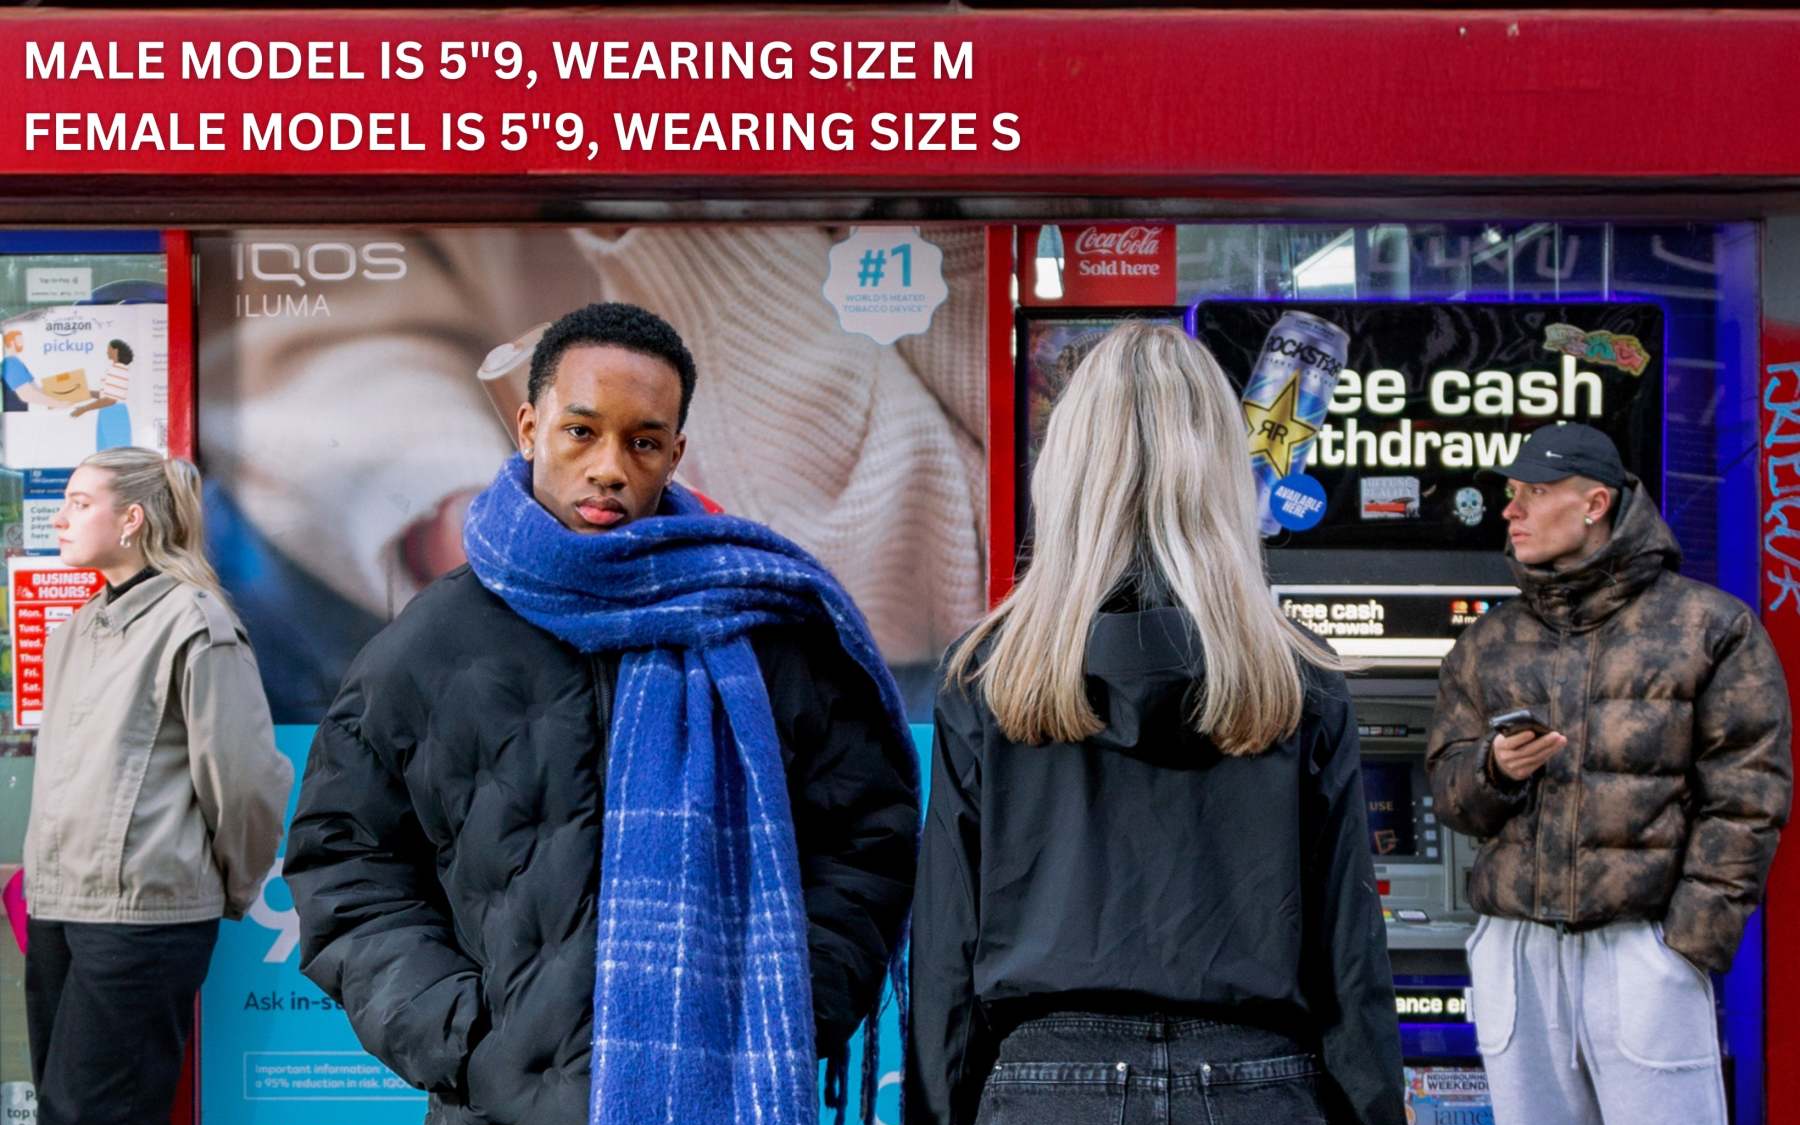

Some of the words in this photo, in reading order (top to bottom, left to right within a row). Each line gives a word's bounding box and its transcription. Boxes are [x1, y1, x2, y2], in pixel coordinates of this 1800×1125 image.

[1076, 226, 1164, 255] Coca-Cola
[236, 242, 408, 287] IQOS
[858, 243, 912, 288] #1
[1079, 260, 1117, 276] Sold
[1120, 260, 1160, 276] here
[889, 294, 926, 302] HEATED
[236, 294, 331, 318] ILUMA
[844, 305, 888, 313] TOBACCO
[46, 320, 92, 332] amazon
[43, 339, 95, 355] pickup
[1326, 367, 1406, 414] ee
[1430, 354, 1603, 415] cash
[1307, 418, 1532, 468] thdraw
[1274, 485, 1324, 513] AVAILABLE
[1281, 498, 1308, 519] HERE
[32, 572, 97, 585] BUSINESS
[38, 585, 91, 598] HOURS:
[18, 609, 43, 618] Mon.
[1283, 600, 1328, 620] free
[1331, 600, 1384, 620] cash
[18, 625, 43, 633] Tues.
[1298, 619, 1384, 637] hdrawals
[19, 640, 43, 648] Wed.
[23, 669, 39, 677] Fri.
[22, 683, 41, 692] Sat.
[22, 697, 43, 706] Sun.
[244, 991, 284, 1011] Ask
[265, 1078, 289, 1089] 95%
[7, 1109, 30, 1120] top
